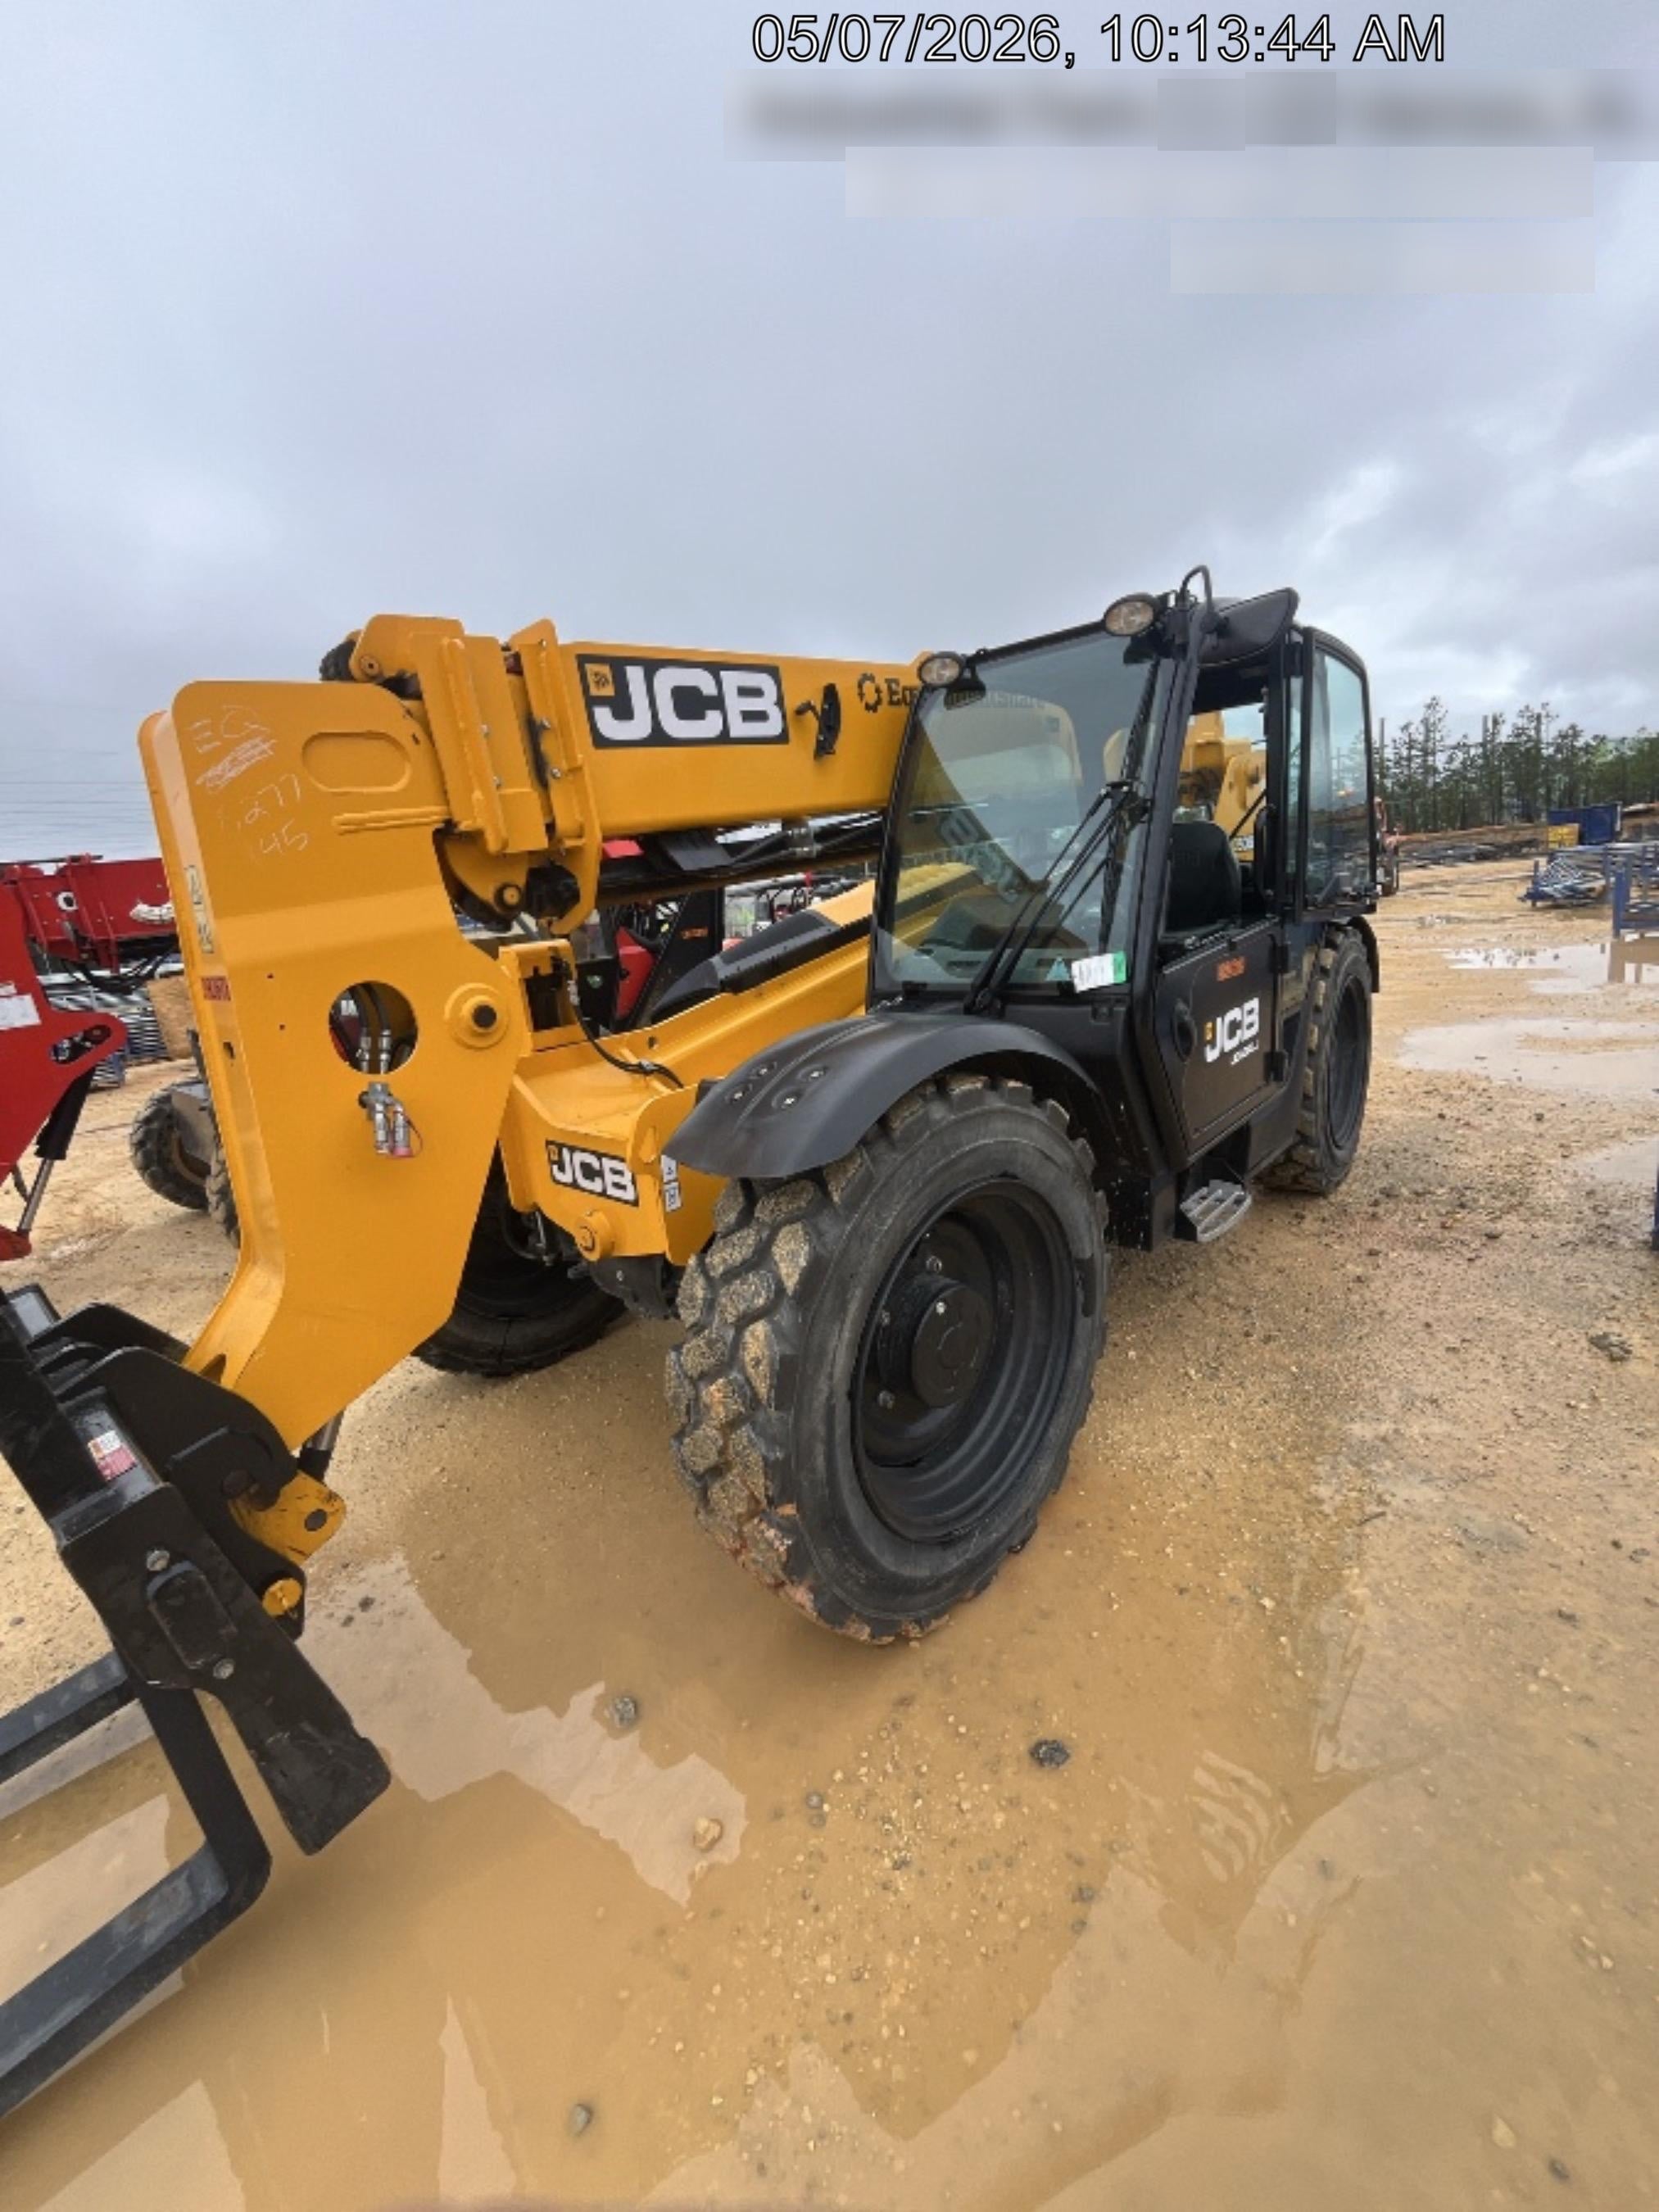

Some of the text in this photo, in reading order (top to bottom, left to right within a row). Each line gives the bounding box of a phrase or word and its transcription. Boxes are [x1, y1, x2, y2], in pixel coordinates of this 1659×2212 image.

[592, 665, 784, 741] JCB
[1204, 997, 1259, 1063] JCB
[551, 1147, 637, 1202] JCB
